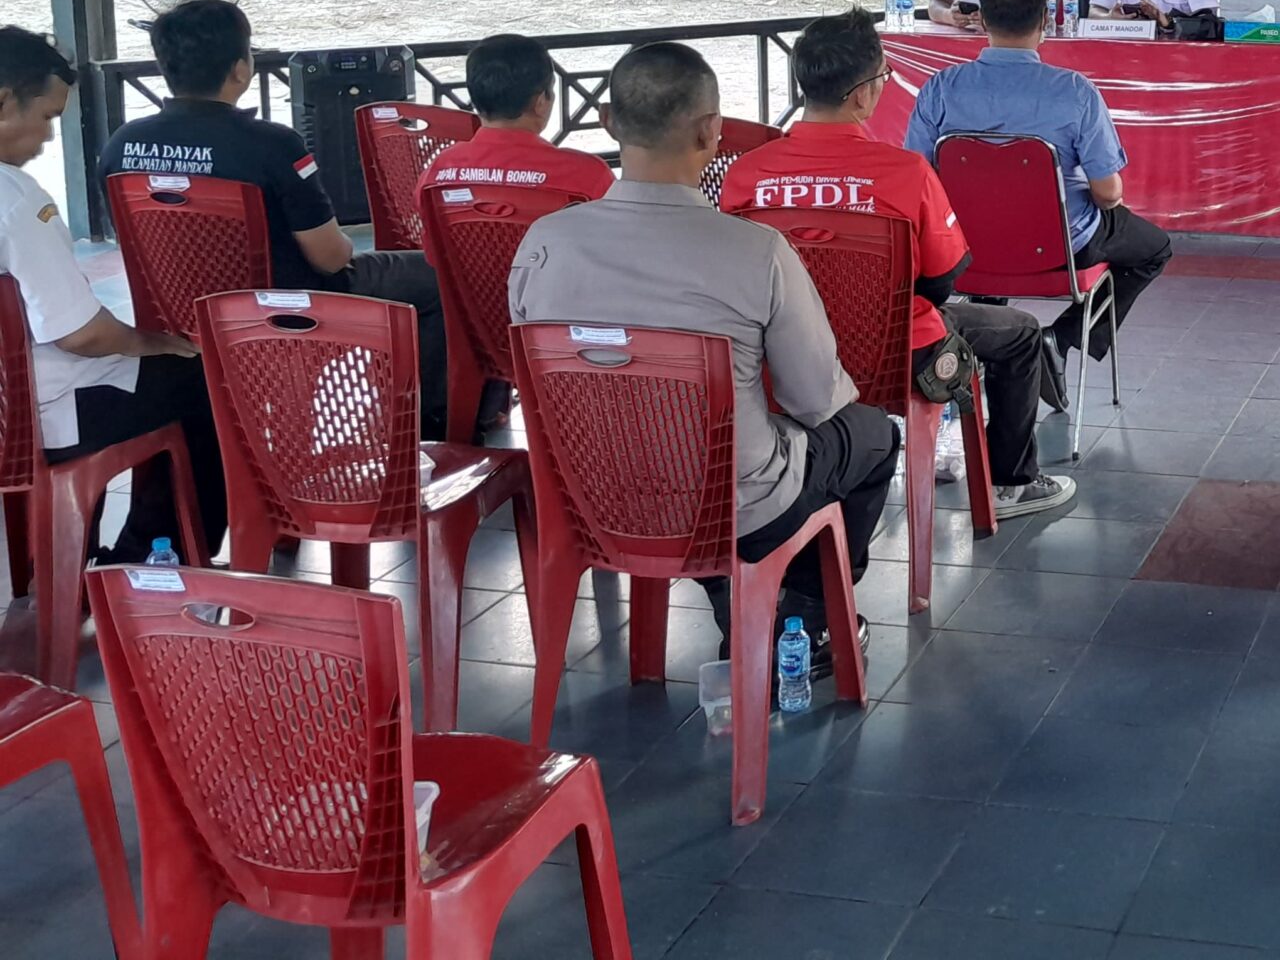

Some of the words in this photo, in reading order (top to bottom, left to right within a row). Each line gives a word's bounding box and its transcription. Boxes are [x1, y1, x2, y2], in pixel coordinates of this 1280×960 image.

[1115, 25, 1144, 33] MANDOR
[123, 142, 159, 157] BALA
[162, 145, 213, 161] DAYAK
[122, 157, 172, 172] KECAMATAN
[173, 160, 213, 174] MANDOR
[459, 168, 504, 182] SAMBILAN
[506, 170, 547, 184] BORNEO
[754, 182, 875, 207] FPDL
